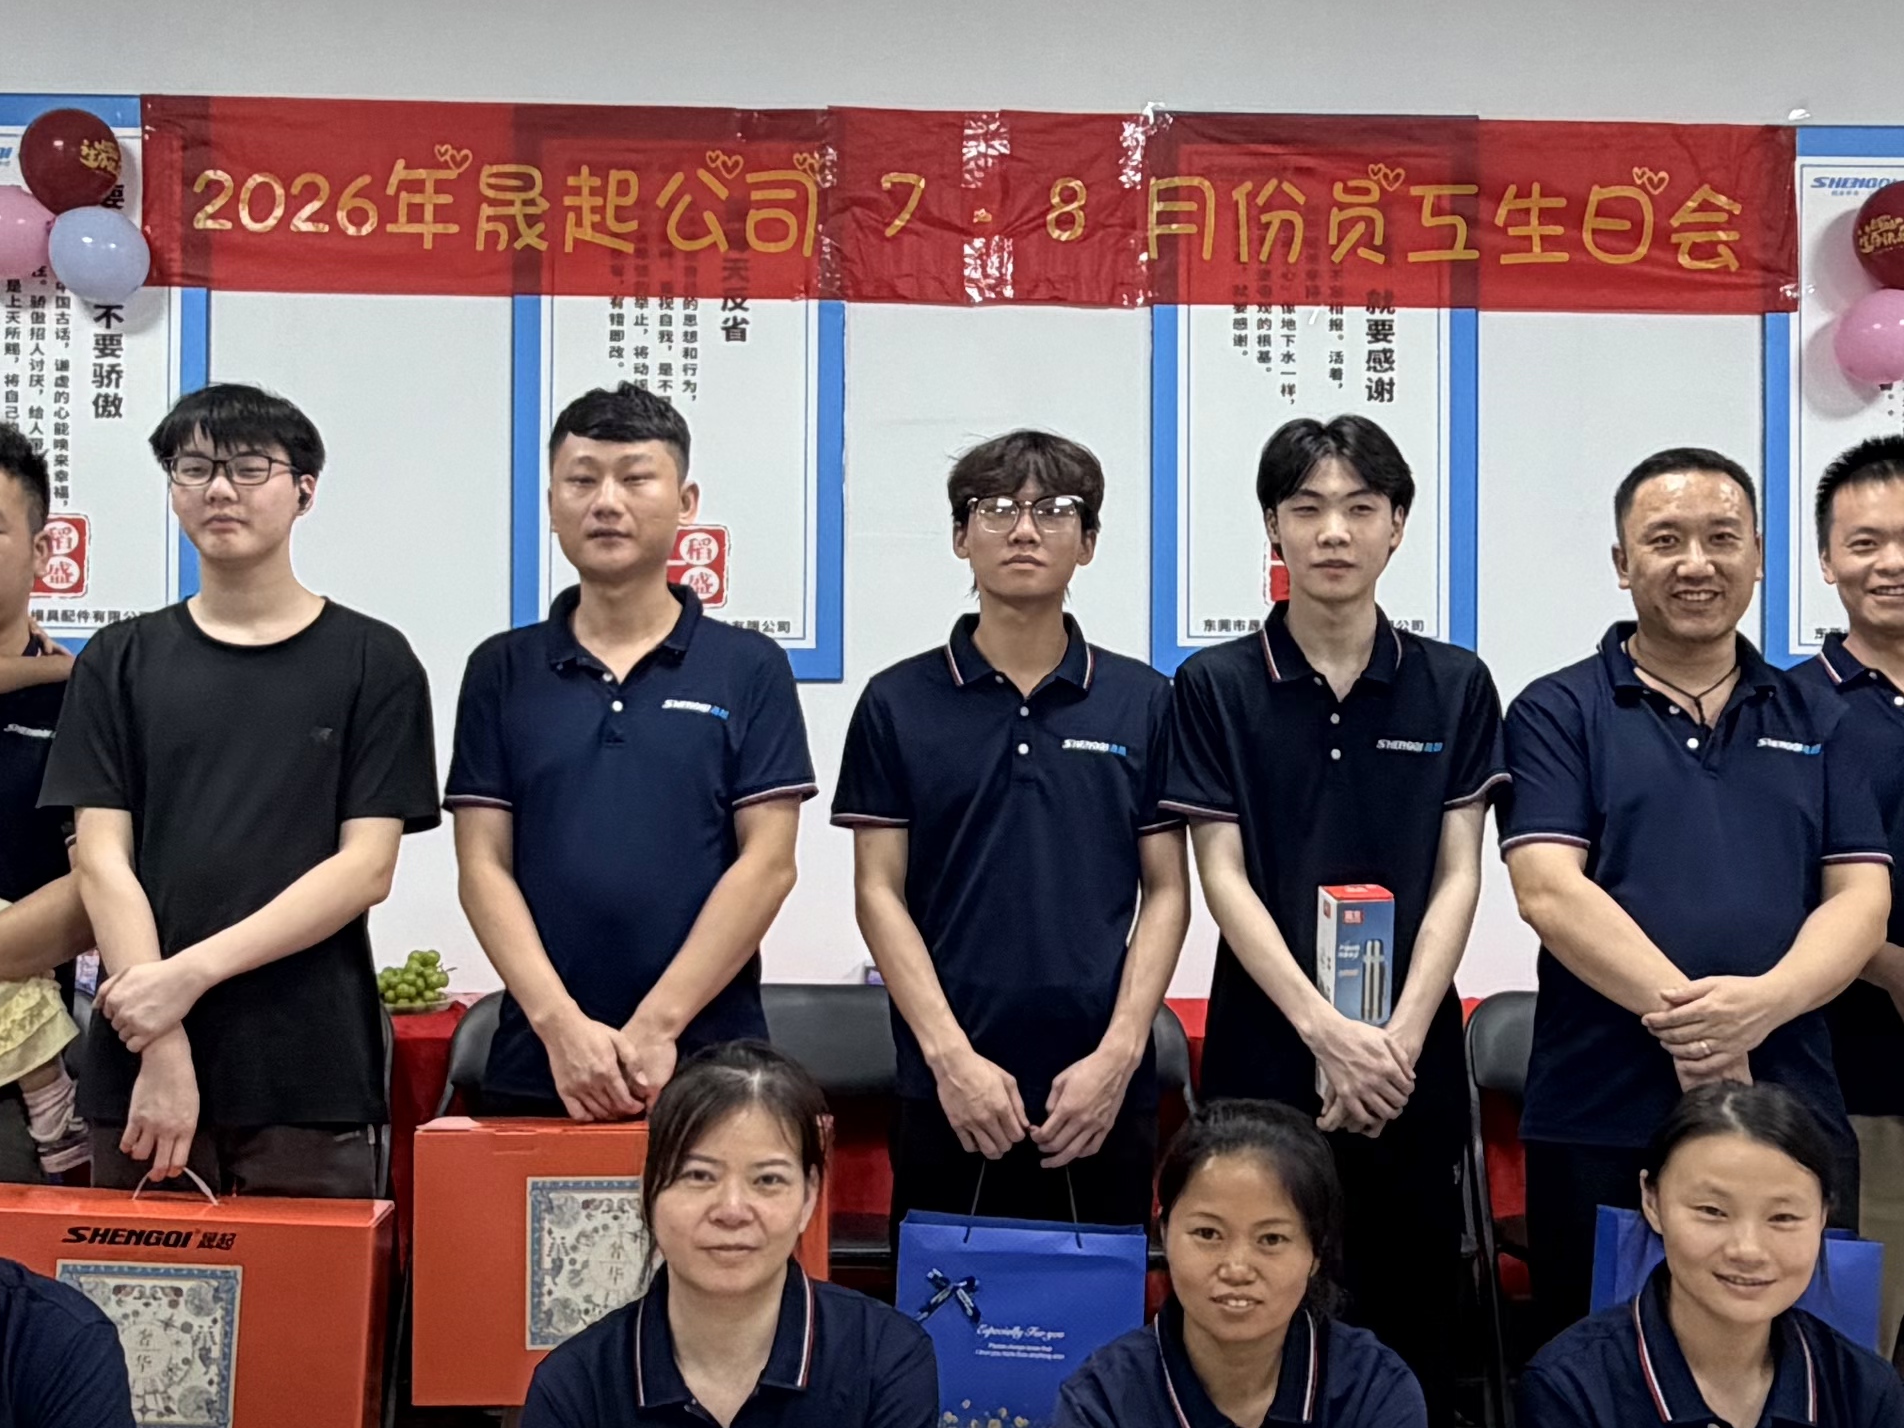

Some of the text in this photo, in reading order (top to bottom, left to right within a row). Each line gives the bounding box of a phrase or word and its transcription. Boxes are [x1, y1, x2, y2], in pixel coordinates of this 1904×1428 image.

[91, 304, 125, 419] 不要骄傲
[32, 609, 154, 623] 模具配件有限公
[61, 1227, 194, 1248] SHENGQI
